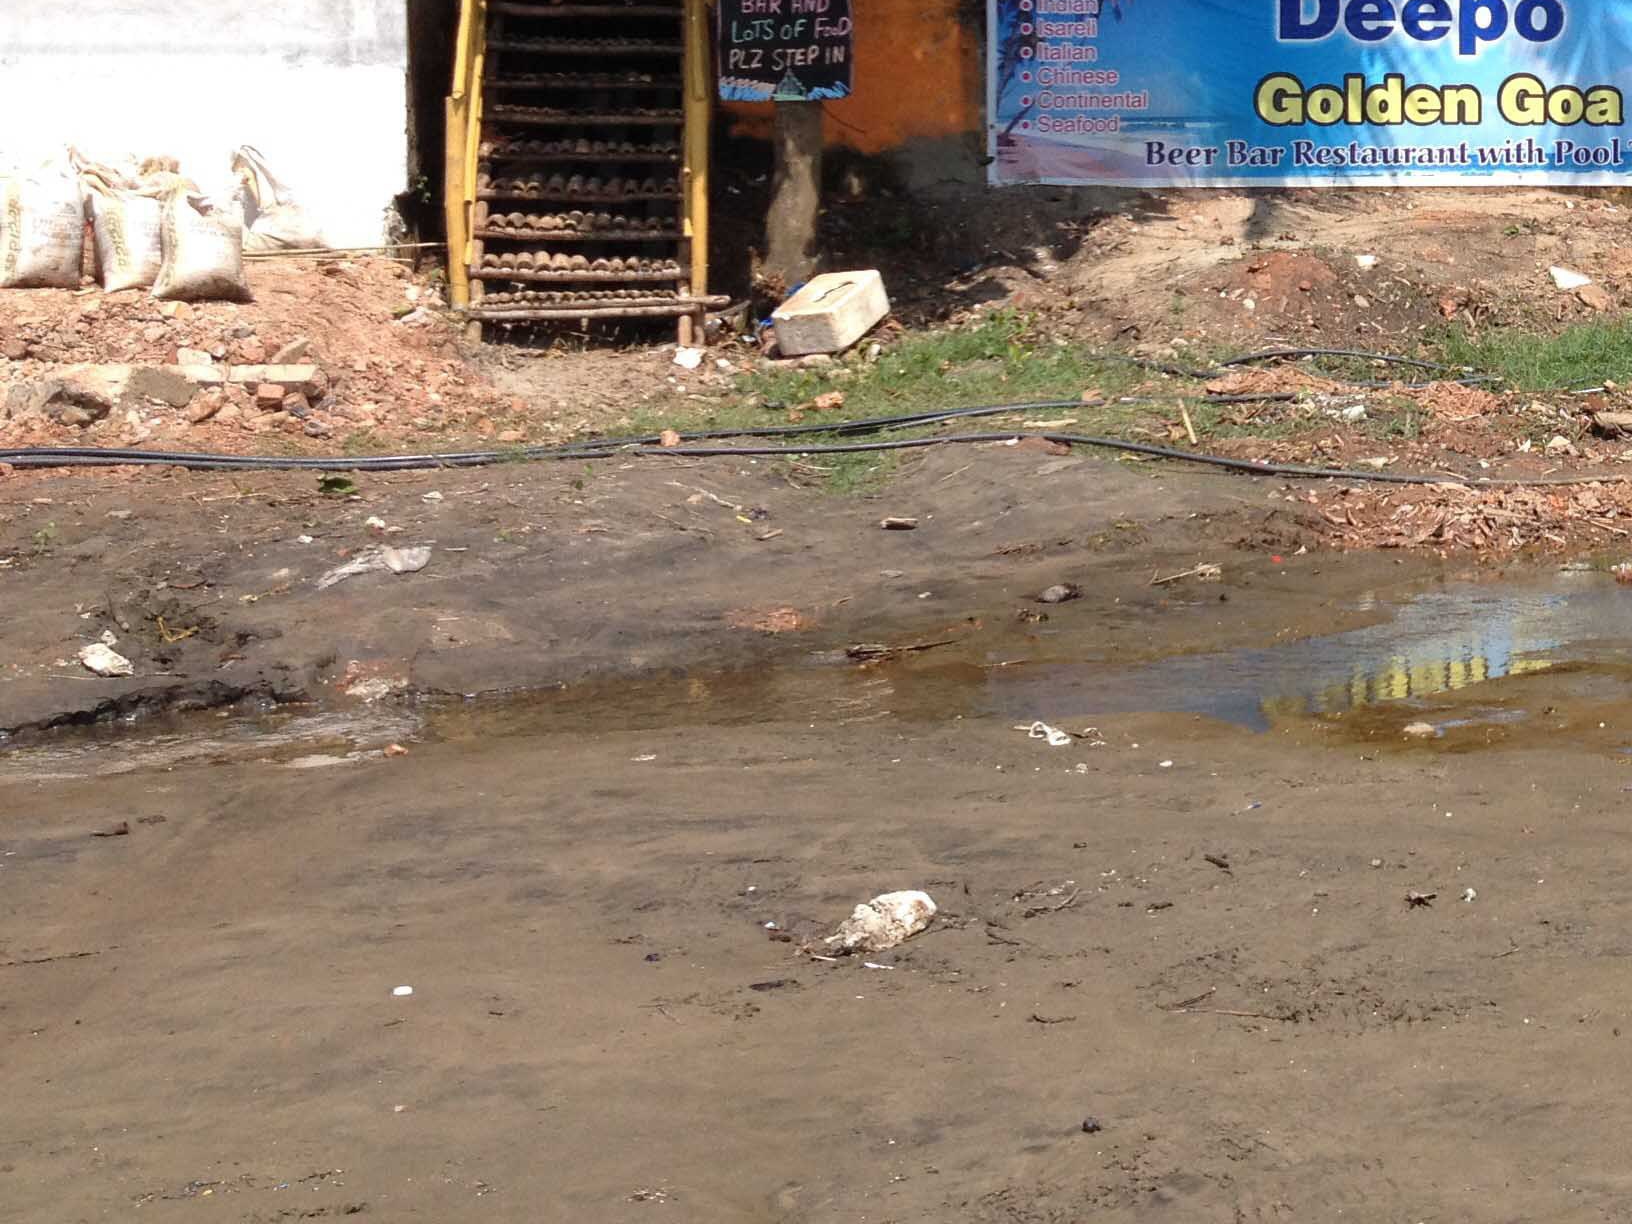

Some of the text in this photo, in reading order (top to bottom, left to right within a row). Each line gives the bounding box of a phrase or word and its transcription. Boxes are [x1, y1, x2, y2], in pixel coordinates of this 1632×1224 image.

[728, 45, 845, 72] PLZ STEP IN
[1036, 43, 1097, 62] Italian
[1036, 66, 1119, 85] Chinese
[1037, 90, 1148, 110] Continental
[1254, 73, 1625, 126] Golden Goa
[1038, 115, 1120, 134] Seafood
[1145, 141, 1219, 167] Beer
[1227, 141, 1285, 167] Bar
[1293, 140, 1471, 167] Restaurant
[1474, 139, 1546, 167] with
[1555, 140, 1622, 167] Pool
